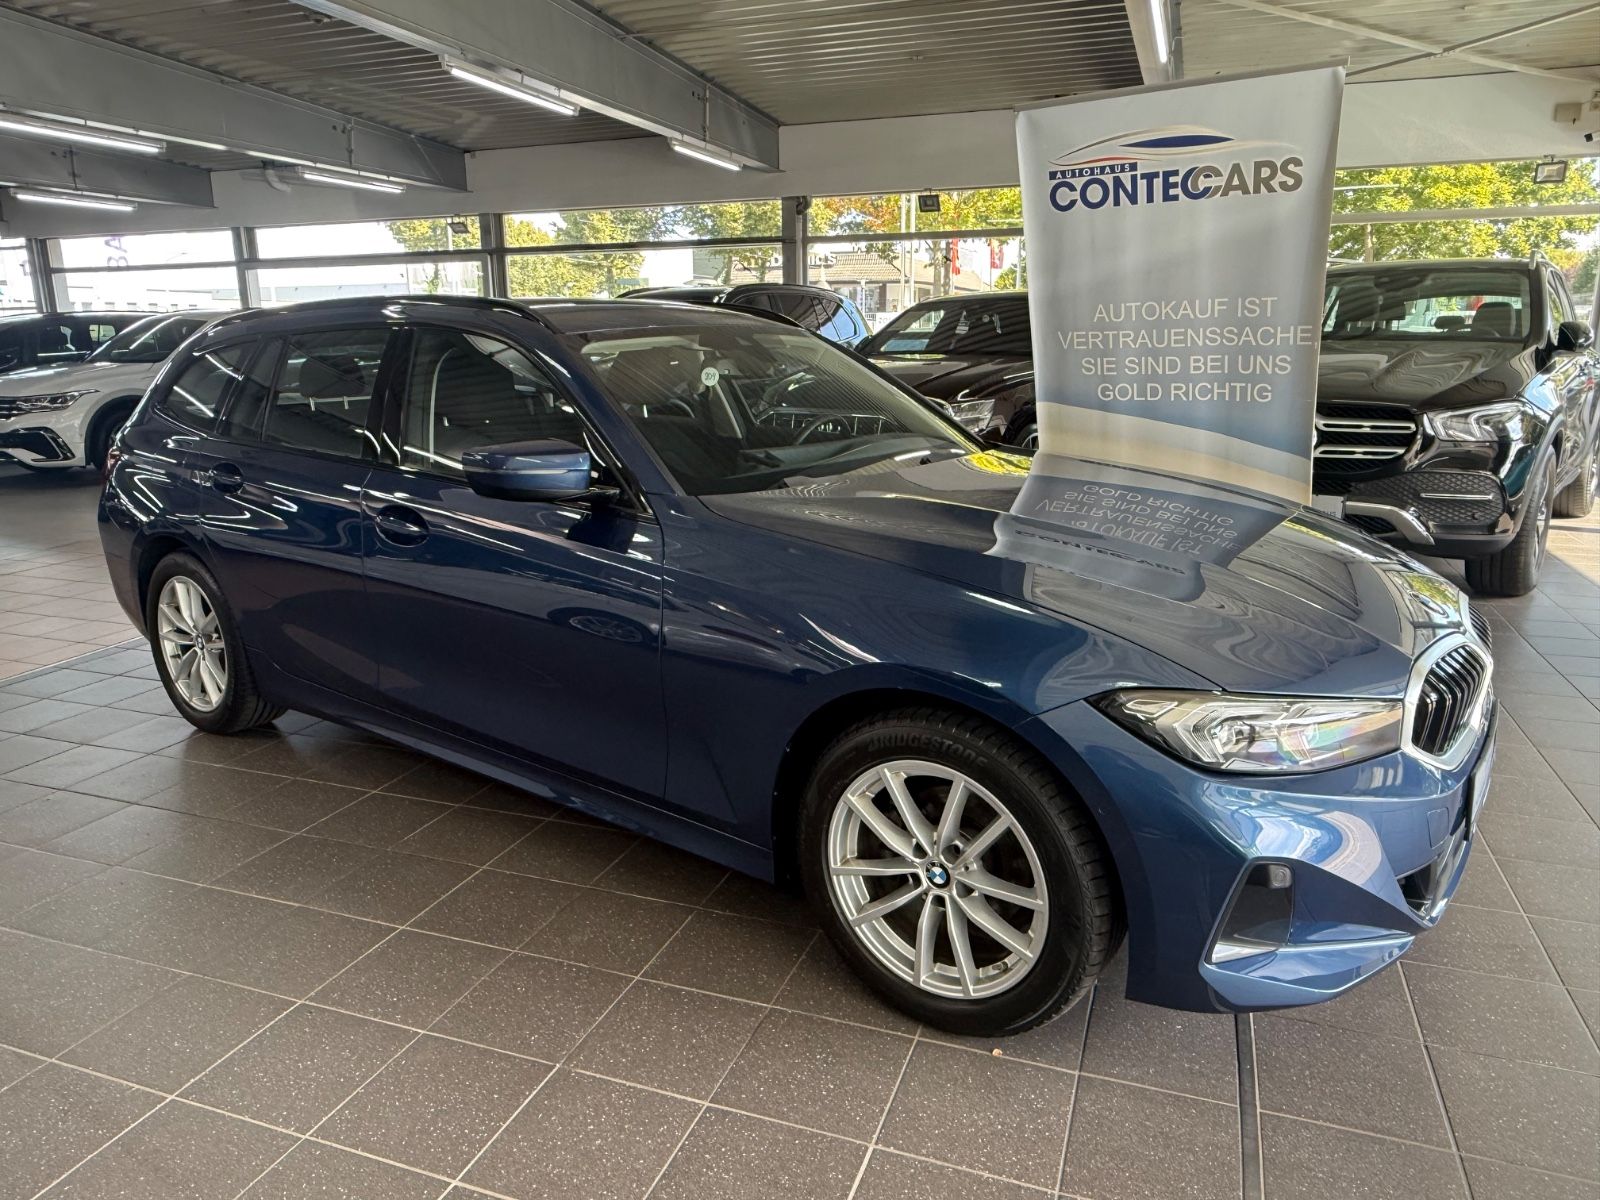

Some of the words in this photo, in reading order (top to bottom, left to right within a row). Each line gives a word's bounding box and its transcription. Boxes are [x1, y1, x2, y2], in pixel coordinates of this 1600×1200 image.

[1055, 162, 1131, 180] AUTOHAUS
[1093, 298, 1229, 322] AUTOKAUF
[1236, 297, 1278, 318] IST
[1058, 325, 1318, 350] VERTRAUENSSACHE,
[1081, 357, 1117, 375] SIE
[1124, 356, 1181, 375] SIND
[1189, 355, 1229, 374] BEI
[1238, 354, 1292, 374] UNS
[1097, 383, 1162, 402] GOLD
[1170, 383, 1273, 403] RICHTIG
[867, 733, 989, 767] BRIDGESTONE
